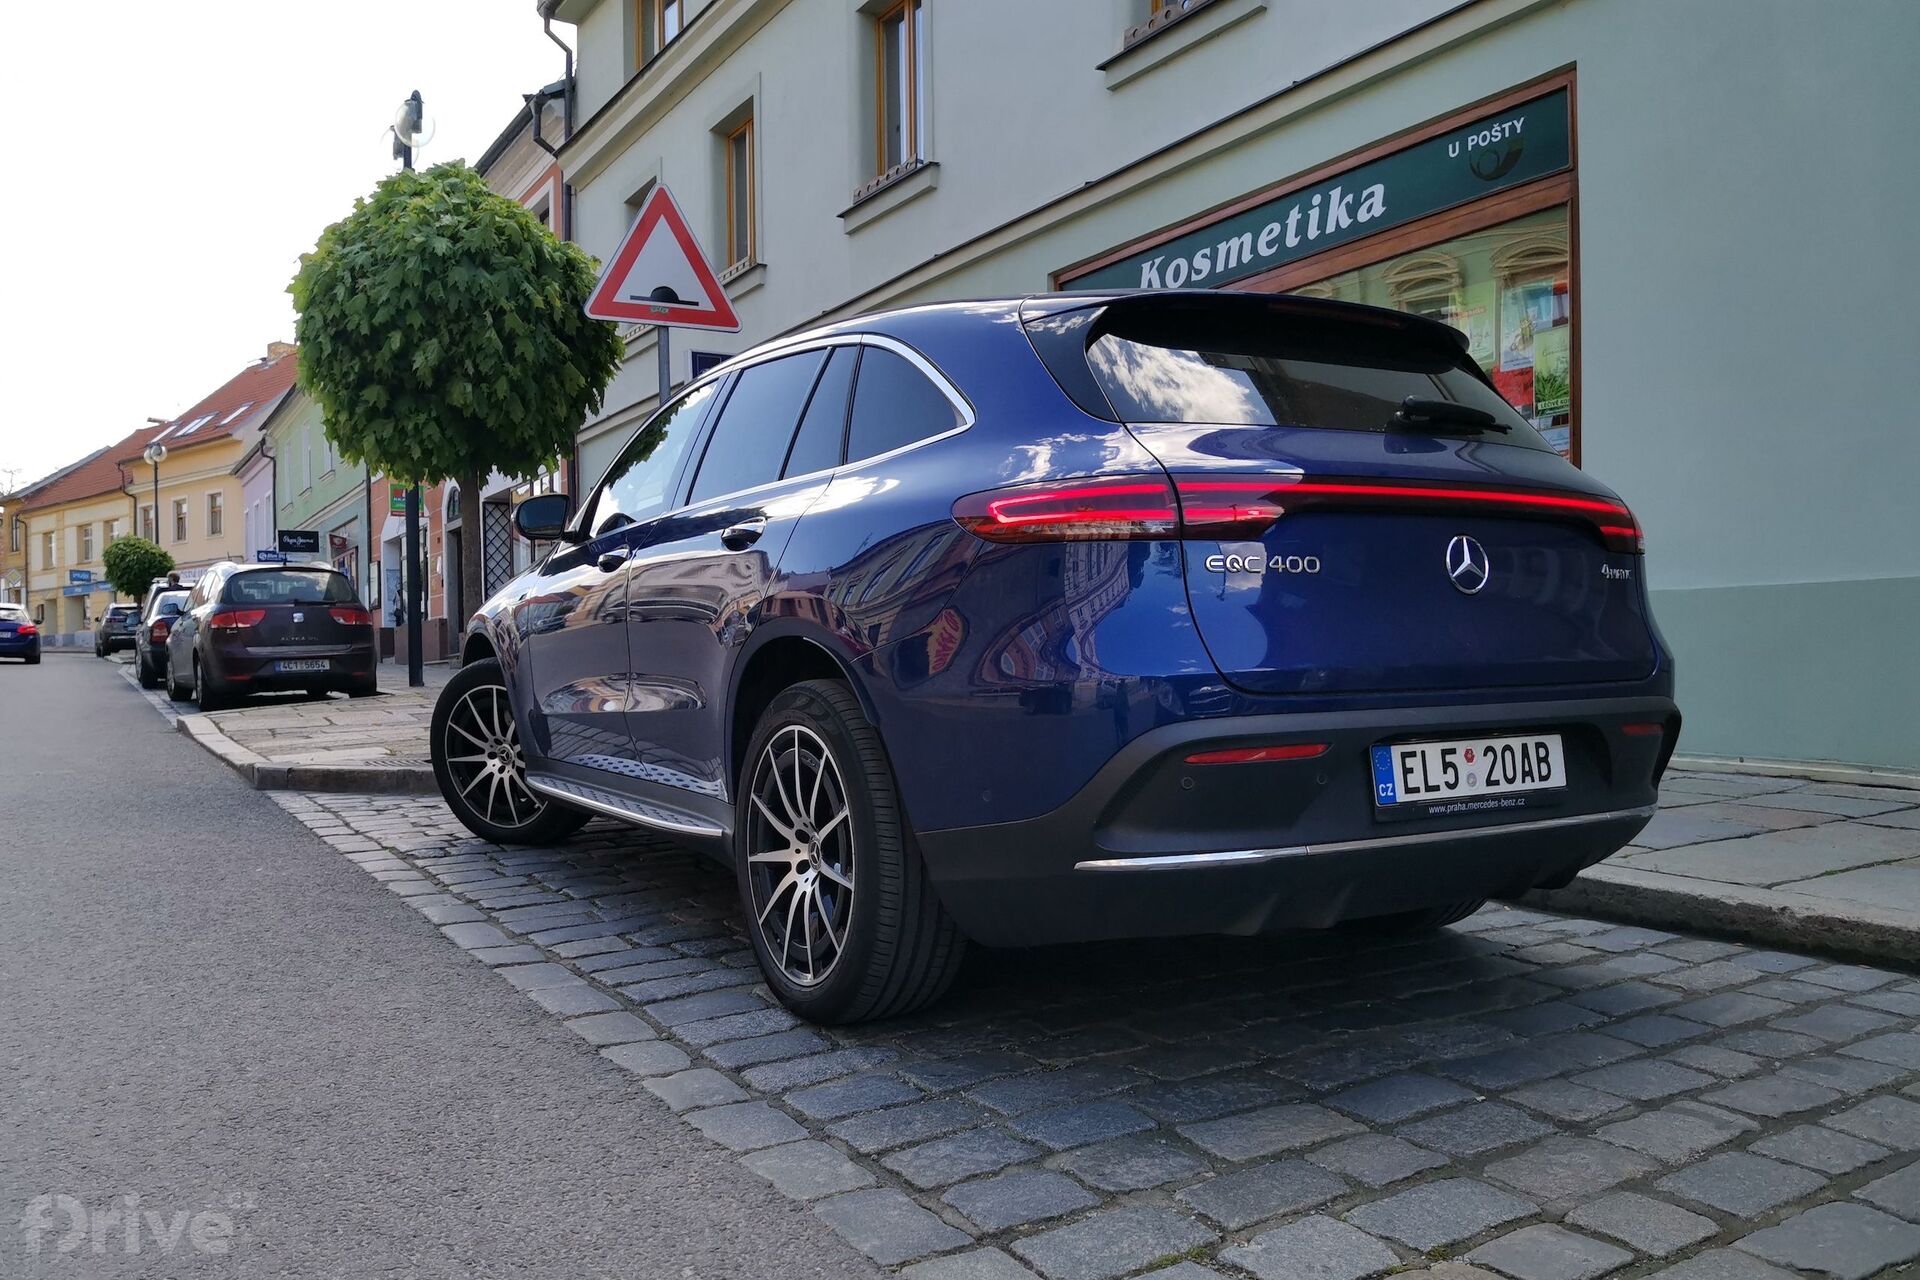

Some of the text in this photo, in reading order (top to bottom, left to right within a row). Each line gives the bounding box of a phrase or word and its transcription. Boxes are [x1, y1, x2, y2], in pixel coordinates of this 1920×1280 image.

[1447, 117, 1526, 158] U POŠTY
[1140, 183, 1387, 289] Kosmetika
[1205, 554, 1321, 574] EQC 400
[1400, 741, 1552, 795] EL5 20AB
[1378, 783, 1394, 797] CZ
[1428, 797, 1526, 814] www.praha.mercedes-benz.cz
